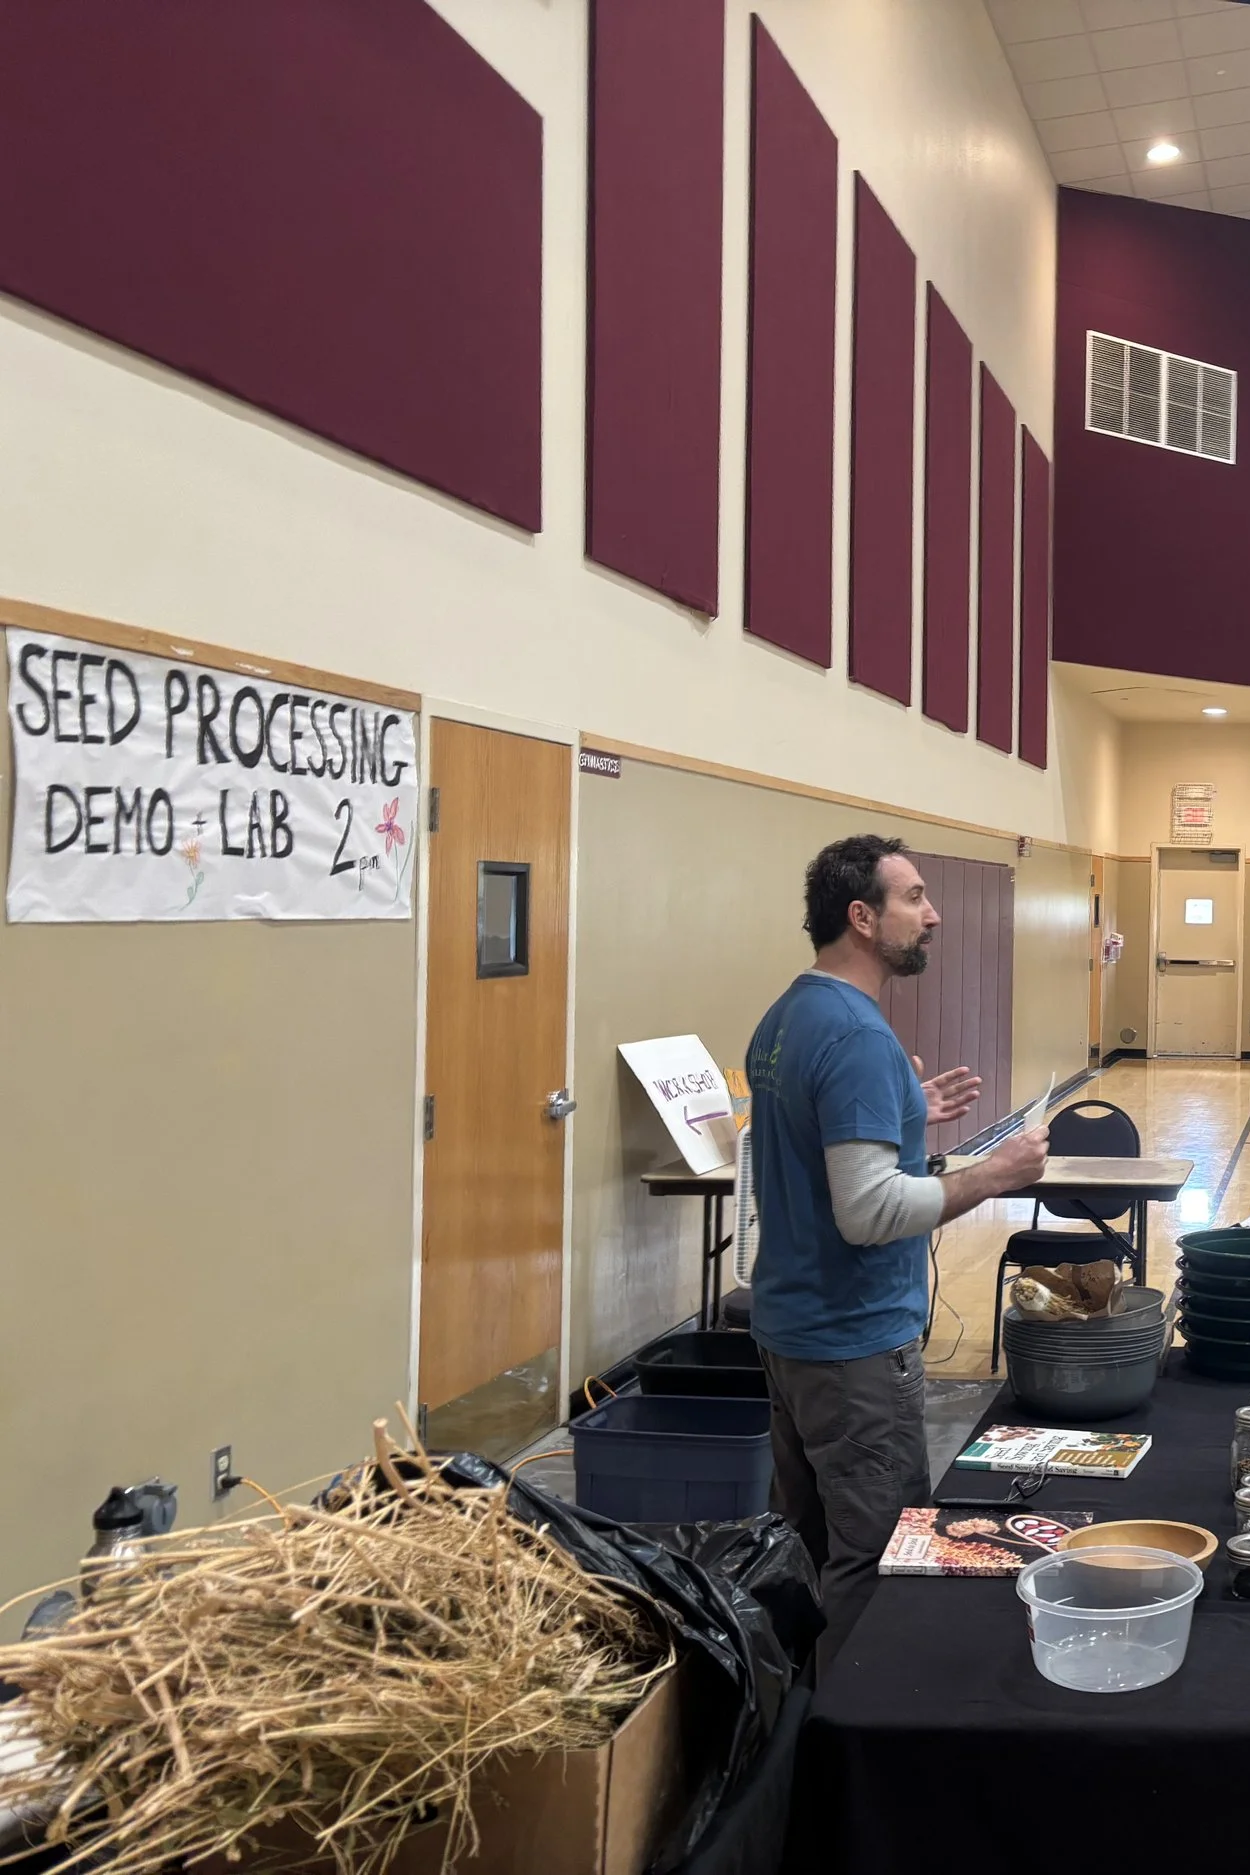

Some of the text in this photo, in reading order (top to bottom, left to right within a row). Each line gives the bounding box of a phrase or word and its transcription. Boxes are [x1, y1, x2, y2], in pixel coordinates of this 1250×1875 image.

[16, 643, 408, 787] SEED PROCESSING
[45, 783, 174, 856] DEMO
[219, 788, 293, 859] LAB
[653, 1069, 719, 1102] WORKSHOP
